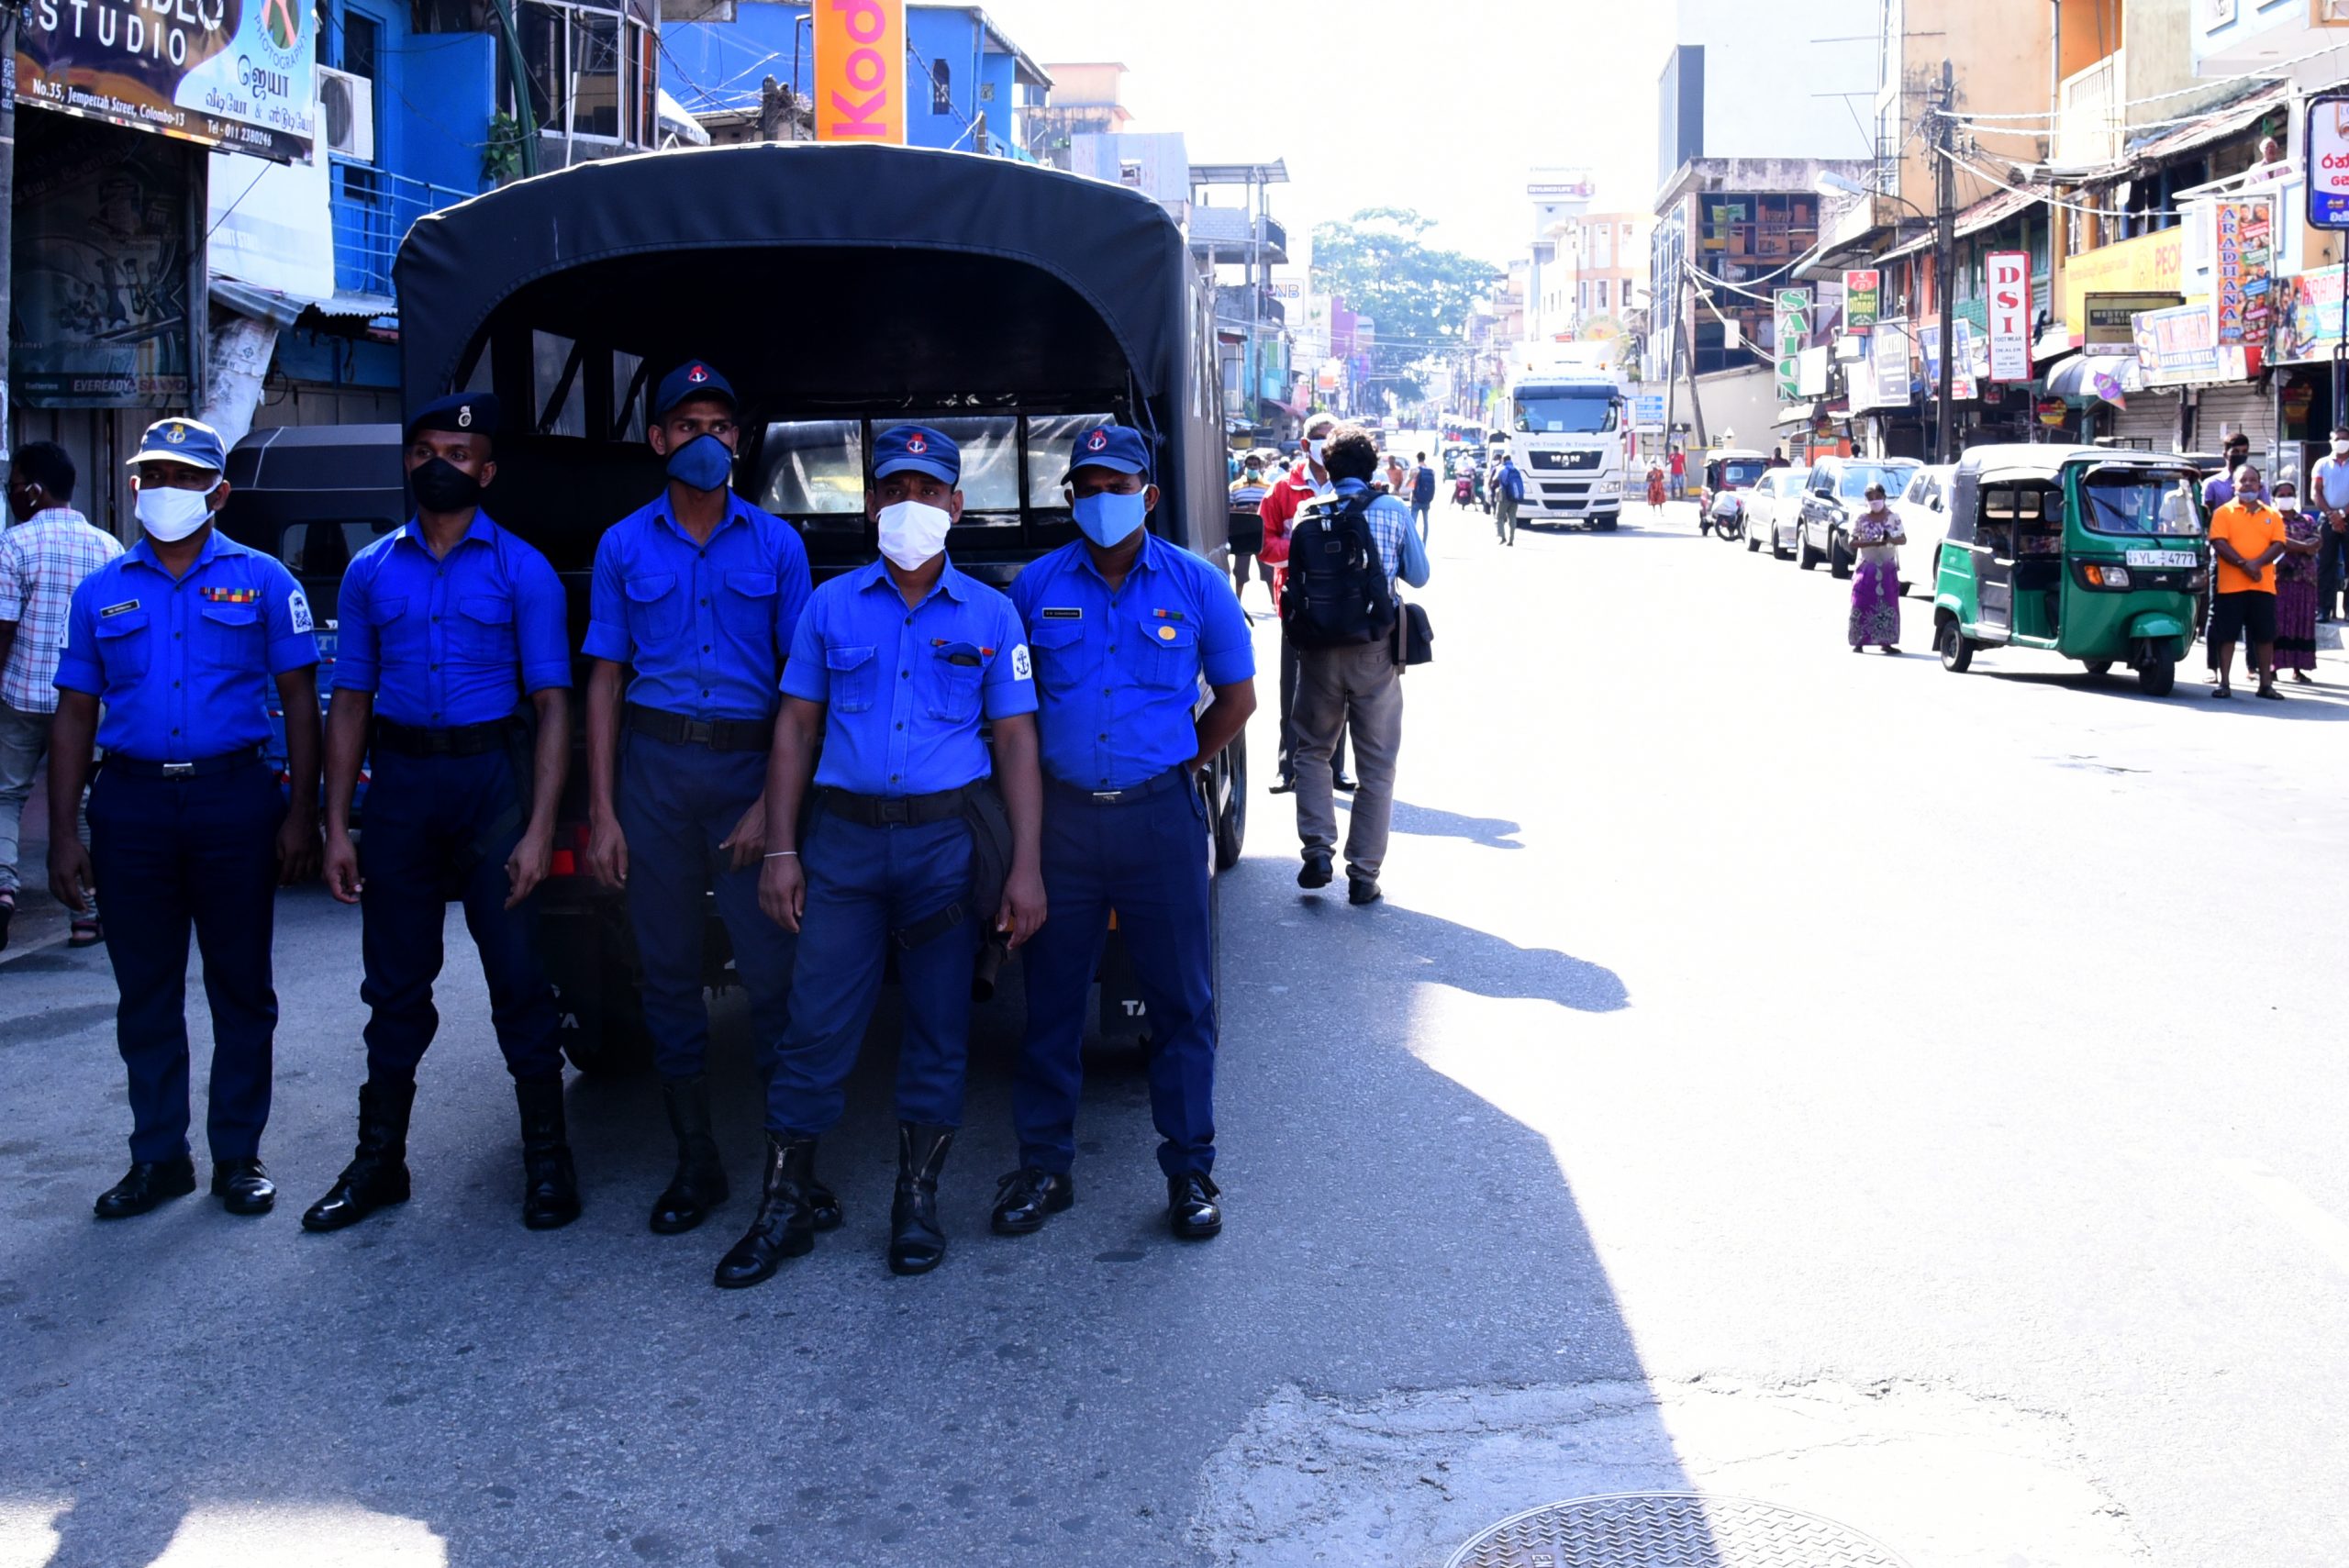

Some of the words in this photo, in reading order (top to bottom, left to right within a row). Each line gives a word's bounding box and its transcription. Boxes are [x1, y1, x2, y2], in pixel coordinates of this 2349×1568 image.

[39, 0, 186, 66] STUDIO
[254, 14, 307, 71] PHOTOGRAPHY
[33, 78, 66, 102] No.35,
[68, 86, 110, 111] Jempettah
[111, 100, 138, 119] Street,
[139, 104, 185, 127] Colombo-13
[207, 119, 219, 134] Tel
[225, 124, 239, 139] 011
[240, 127, 273, 147] 2380246
[2221, 208, 2237, 320] ARADHANA
[1848, 296, 1876, 314] Dinner
[1997, 266, 2021, 334] DSI
[73, 379, 130, 393] EVEREADY
[139, 377, 187, 392] SANYO
[2139, 551, 2154, 564] YL
[2168, 552, 2194, 565] 4777
